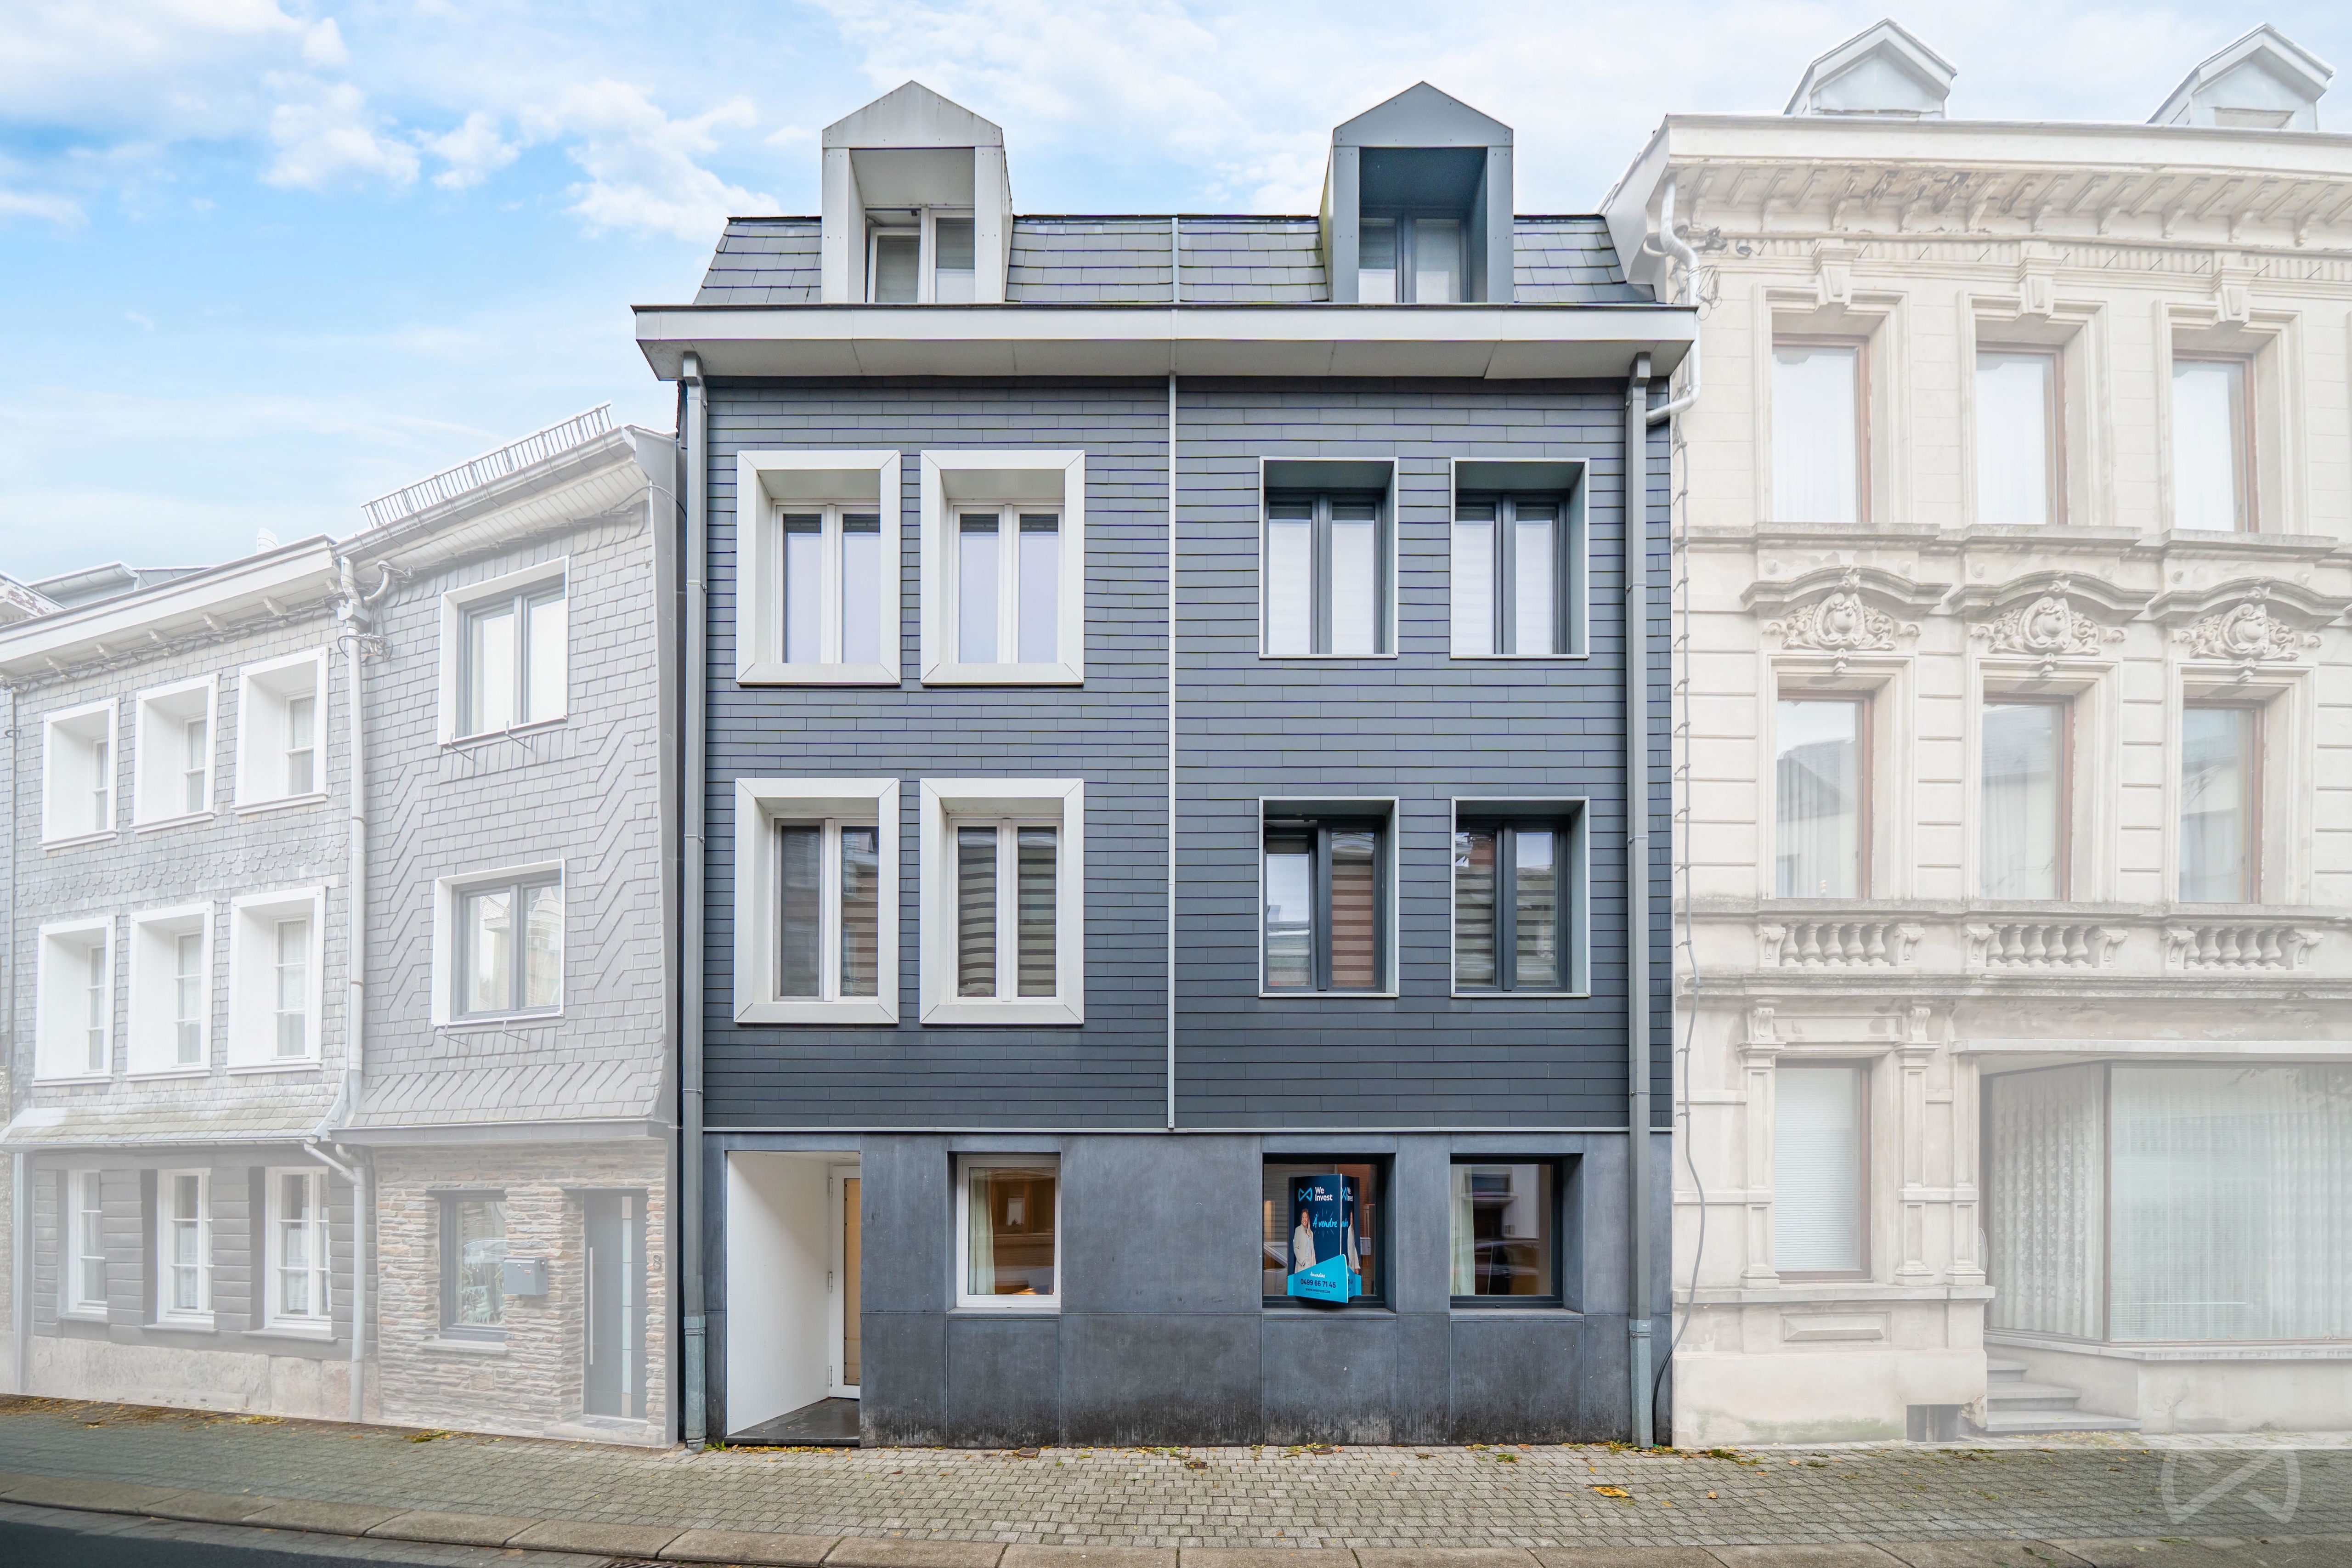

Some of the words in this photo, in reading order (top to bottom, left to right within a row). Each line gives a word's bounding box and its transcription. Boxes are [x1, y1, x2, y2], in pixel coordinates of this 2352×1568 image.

[1312, 1214, 1318, 1228] À
[1318, 1218, 1337, 1228] vendre
[653, 1255, 662, 1269] 8
